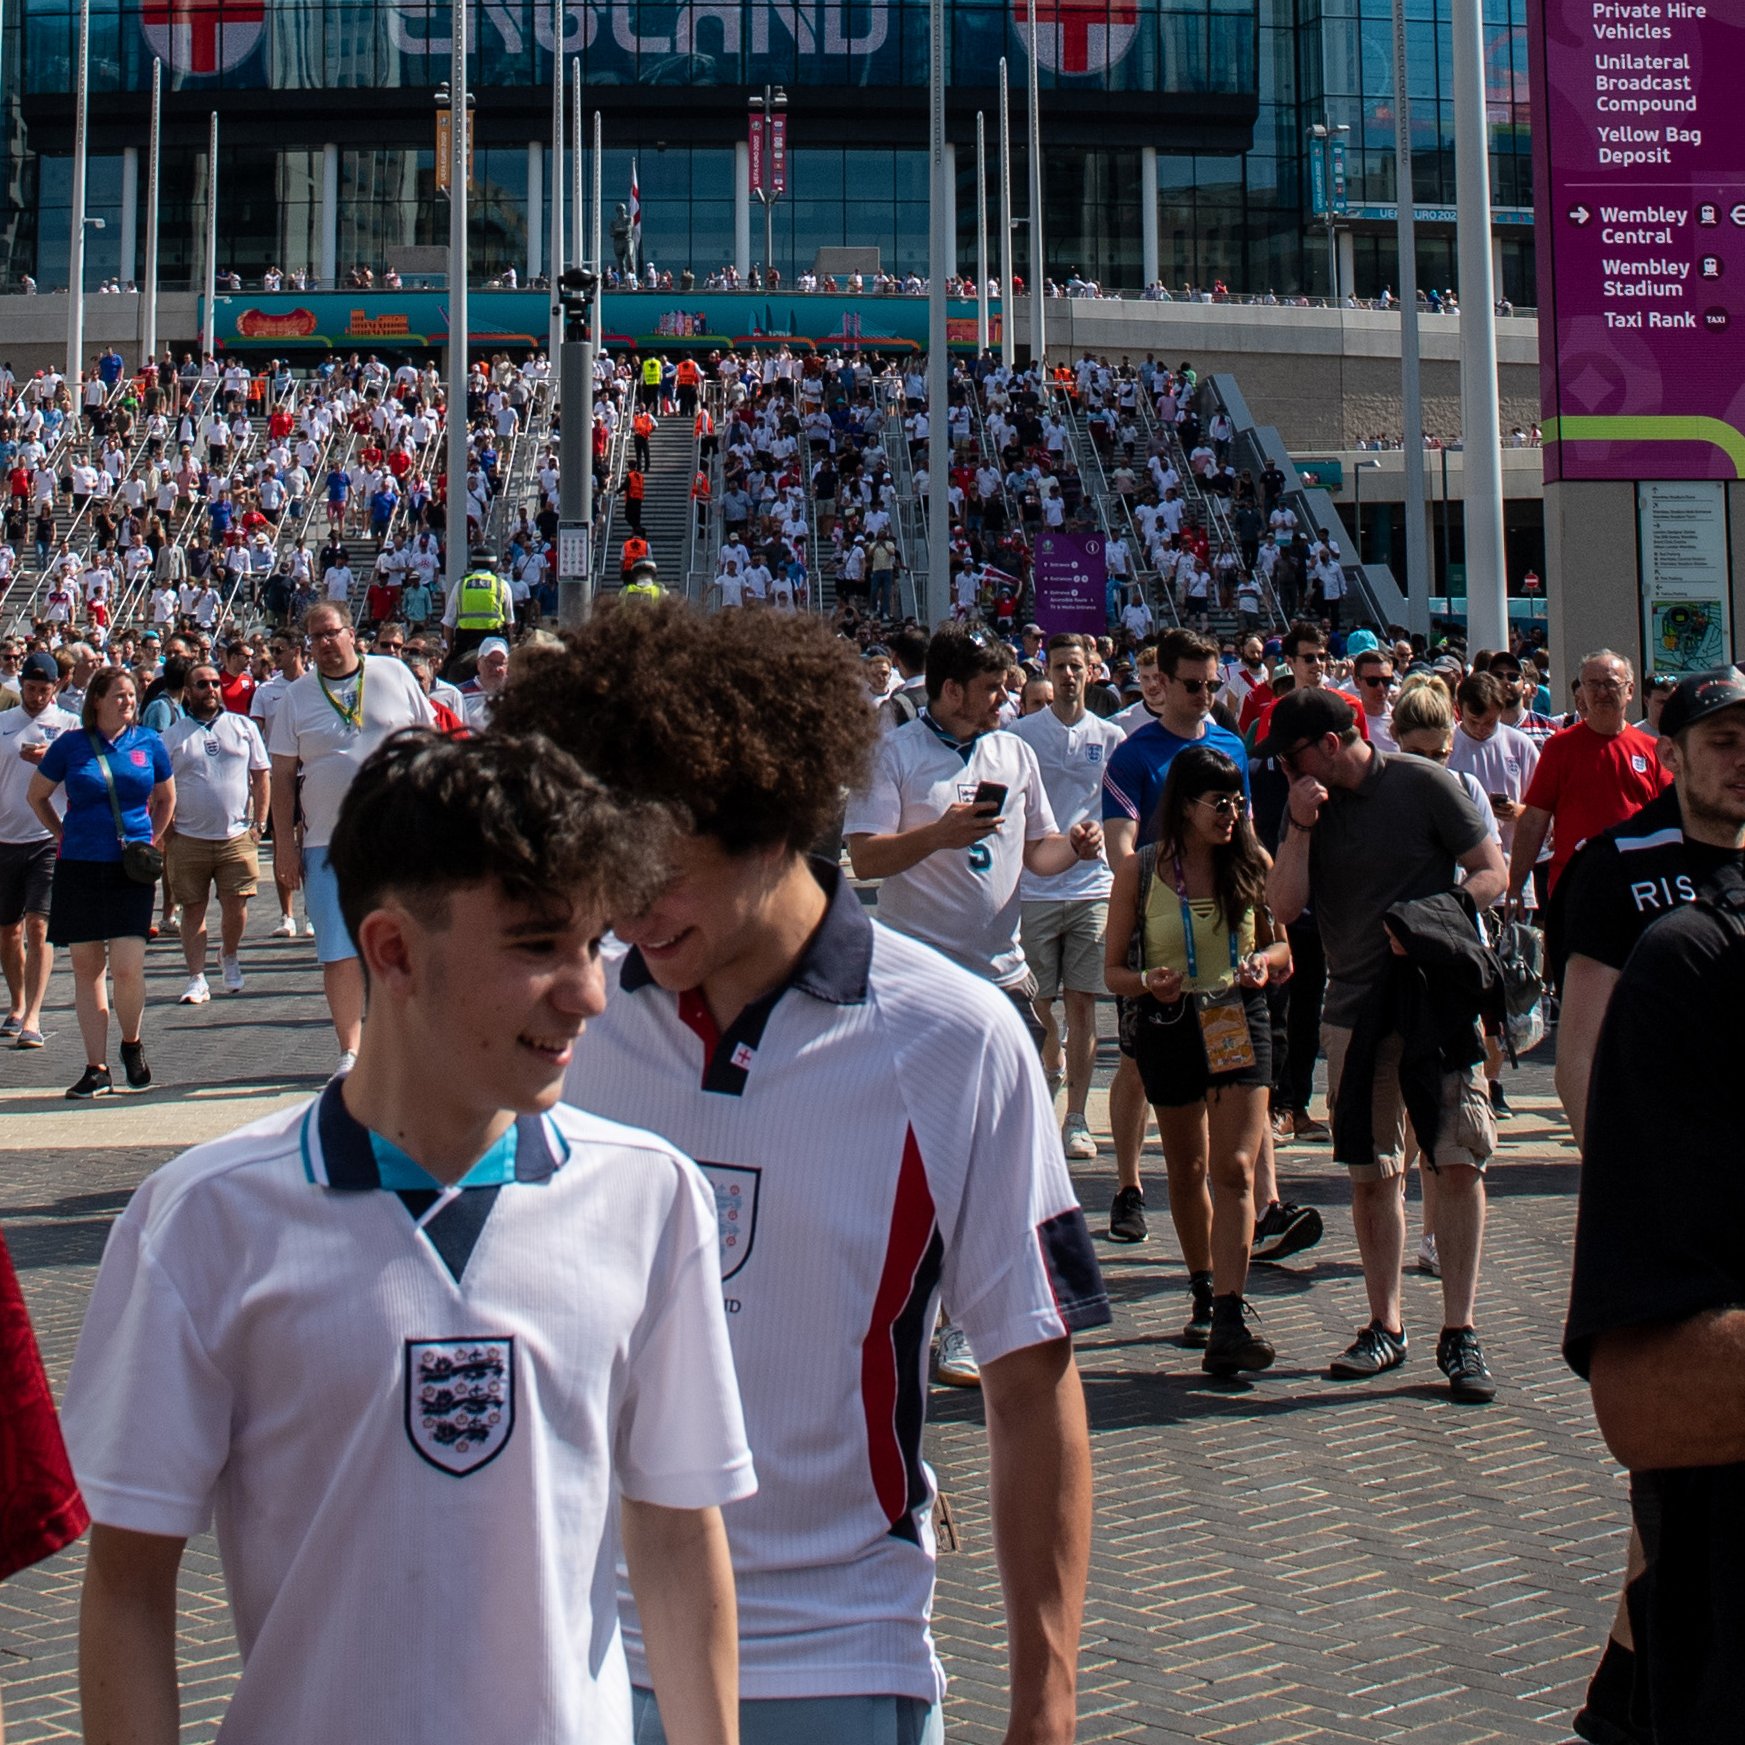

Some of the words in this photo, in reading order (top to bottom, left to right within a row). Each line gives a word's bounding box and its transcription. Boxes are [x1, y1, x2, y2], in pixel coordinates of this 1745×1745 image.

[1594, 3, 1661, 18] Private
[1668, 3, 1706, 18] Hire
[1593, 23, 1671, 38] Vehicles
[1596, 54, 1690, 69] Unilateral
[1597, 75, 1691, 90] Broadcast
[1597, 96, 1696, 115] Compound
[1598, 126, 1659, 142] Yellow
[1666, 127, 1701, 146] Bag
[1599, 148, 1671, 167] Deposit
[1413, 210, 1436, 220] URO
[1437, 211, 1457, 221] 202
[1600, 206, 1687, 226] Wembley
[1602, 228, 1672, 243] Central
[1603, 259, 1689, 279] Wembley
[1604, 280, 1682, 296] Stadium
[1604, 312, 1641, 327] Taxi
[1649, 311, 1695, 327] Rank
